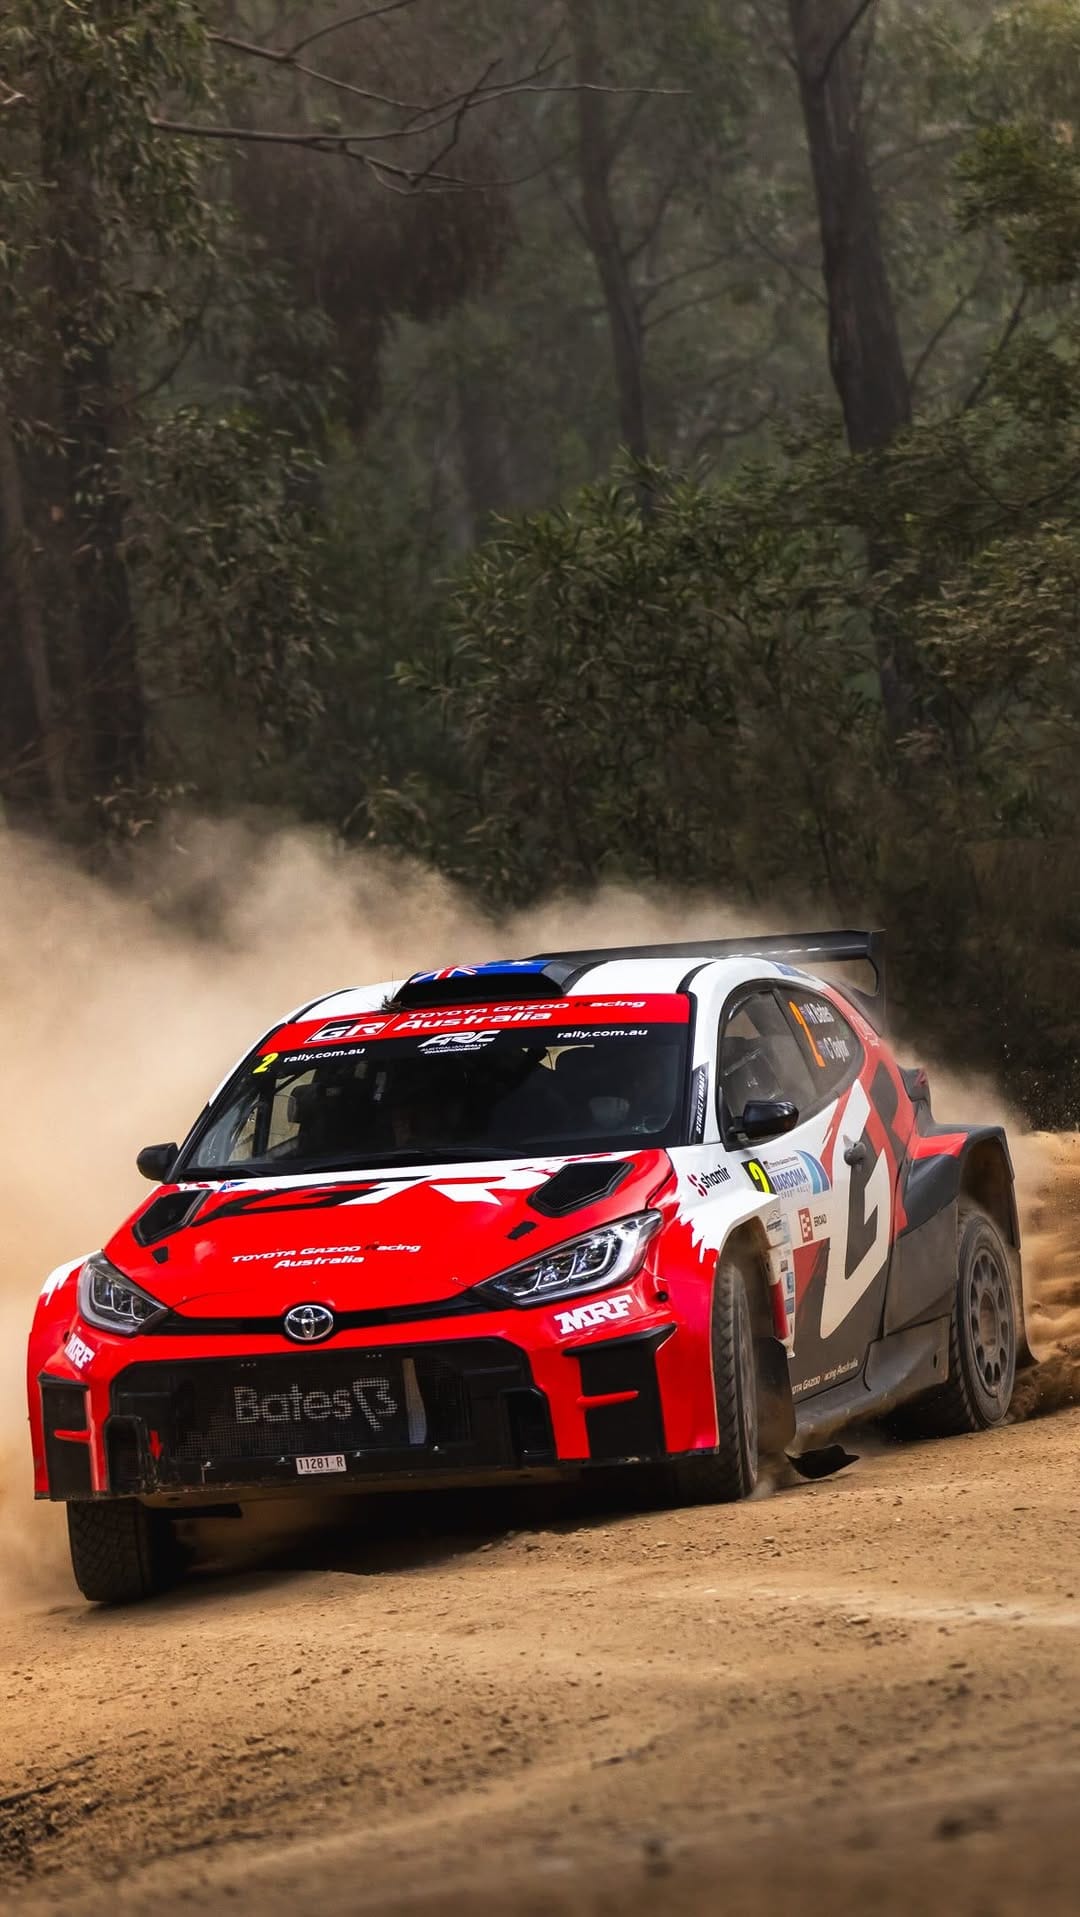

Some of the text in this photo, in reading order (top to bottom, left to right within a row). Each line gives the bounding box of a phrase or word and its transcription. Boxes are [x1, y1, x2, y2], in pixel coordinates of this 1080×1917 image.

[393, 1011, 553, 1031] Australia
[408, 1007, 488, 1020] TOYOTA
[493, 1003, 570, 1013] GAZOO
[311, 1022, 386, 1041] GR
[417, 1030, 501, 1049] ARC
[557, 1030, 648, 1039] rally.com.au
[252, 1052, 279, 1074] 2
[283, 1048, 366, 1063] rally.com.au
[700, 1164, 731, 1189] shamir
[771, 1168, 808, 1191] NAROOMA
[232, 1249, 297, 1263] TOYOTA
[300, 1245, 361, 1256] GAZOO
[273, 1255, 366, 1270] Australia
[553, 1294, 633, 1335] MRF
[64, 1332, 96, 1369] MRF
[233, 1383, 352, 1424] Bates
